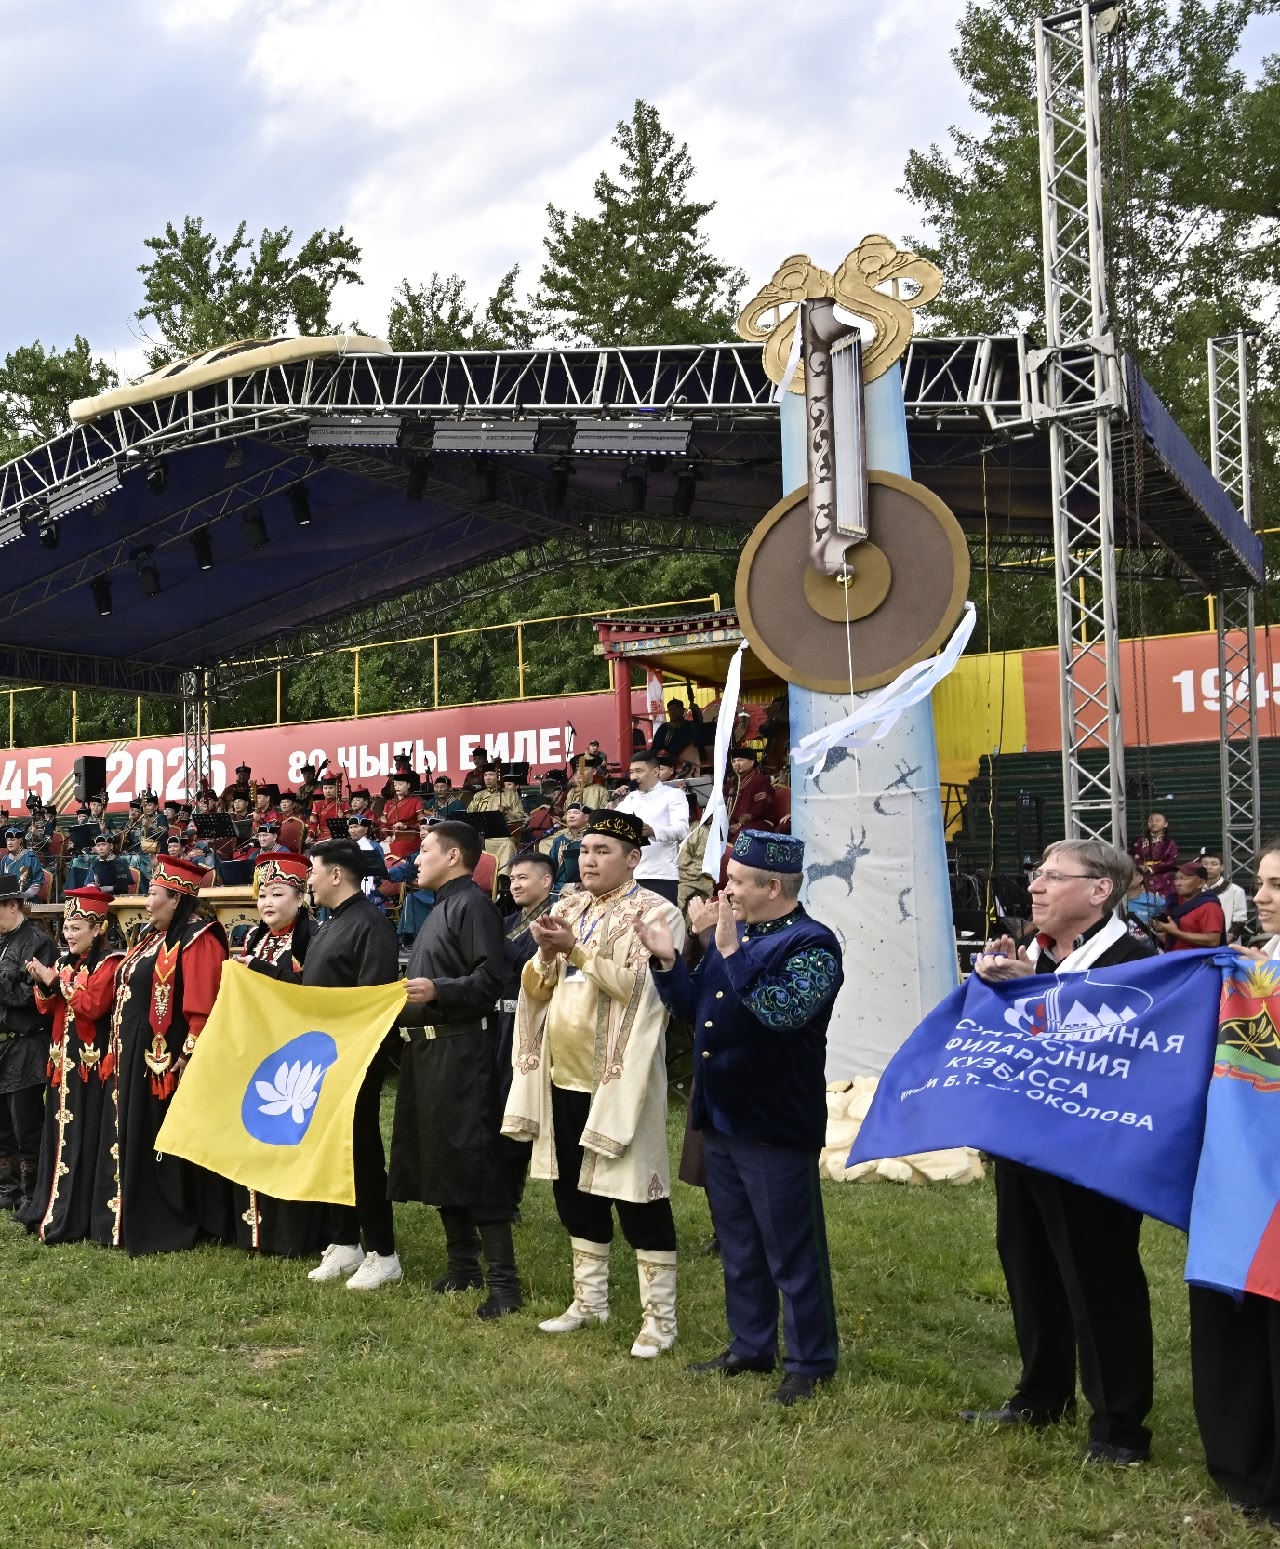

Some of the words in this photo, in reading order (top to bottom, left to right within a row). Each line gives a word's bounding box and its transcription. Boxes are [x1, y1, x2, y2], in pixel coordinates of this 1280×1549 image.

[1172, 662, 1280, 713] 194
[106, 743, 227, 804] 2025
[337, 736, 448, 779] ЧЫЛЫ
